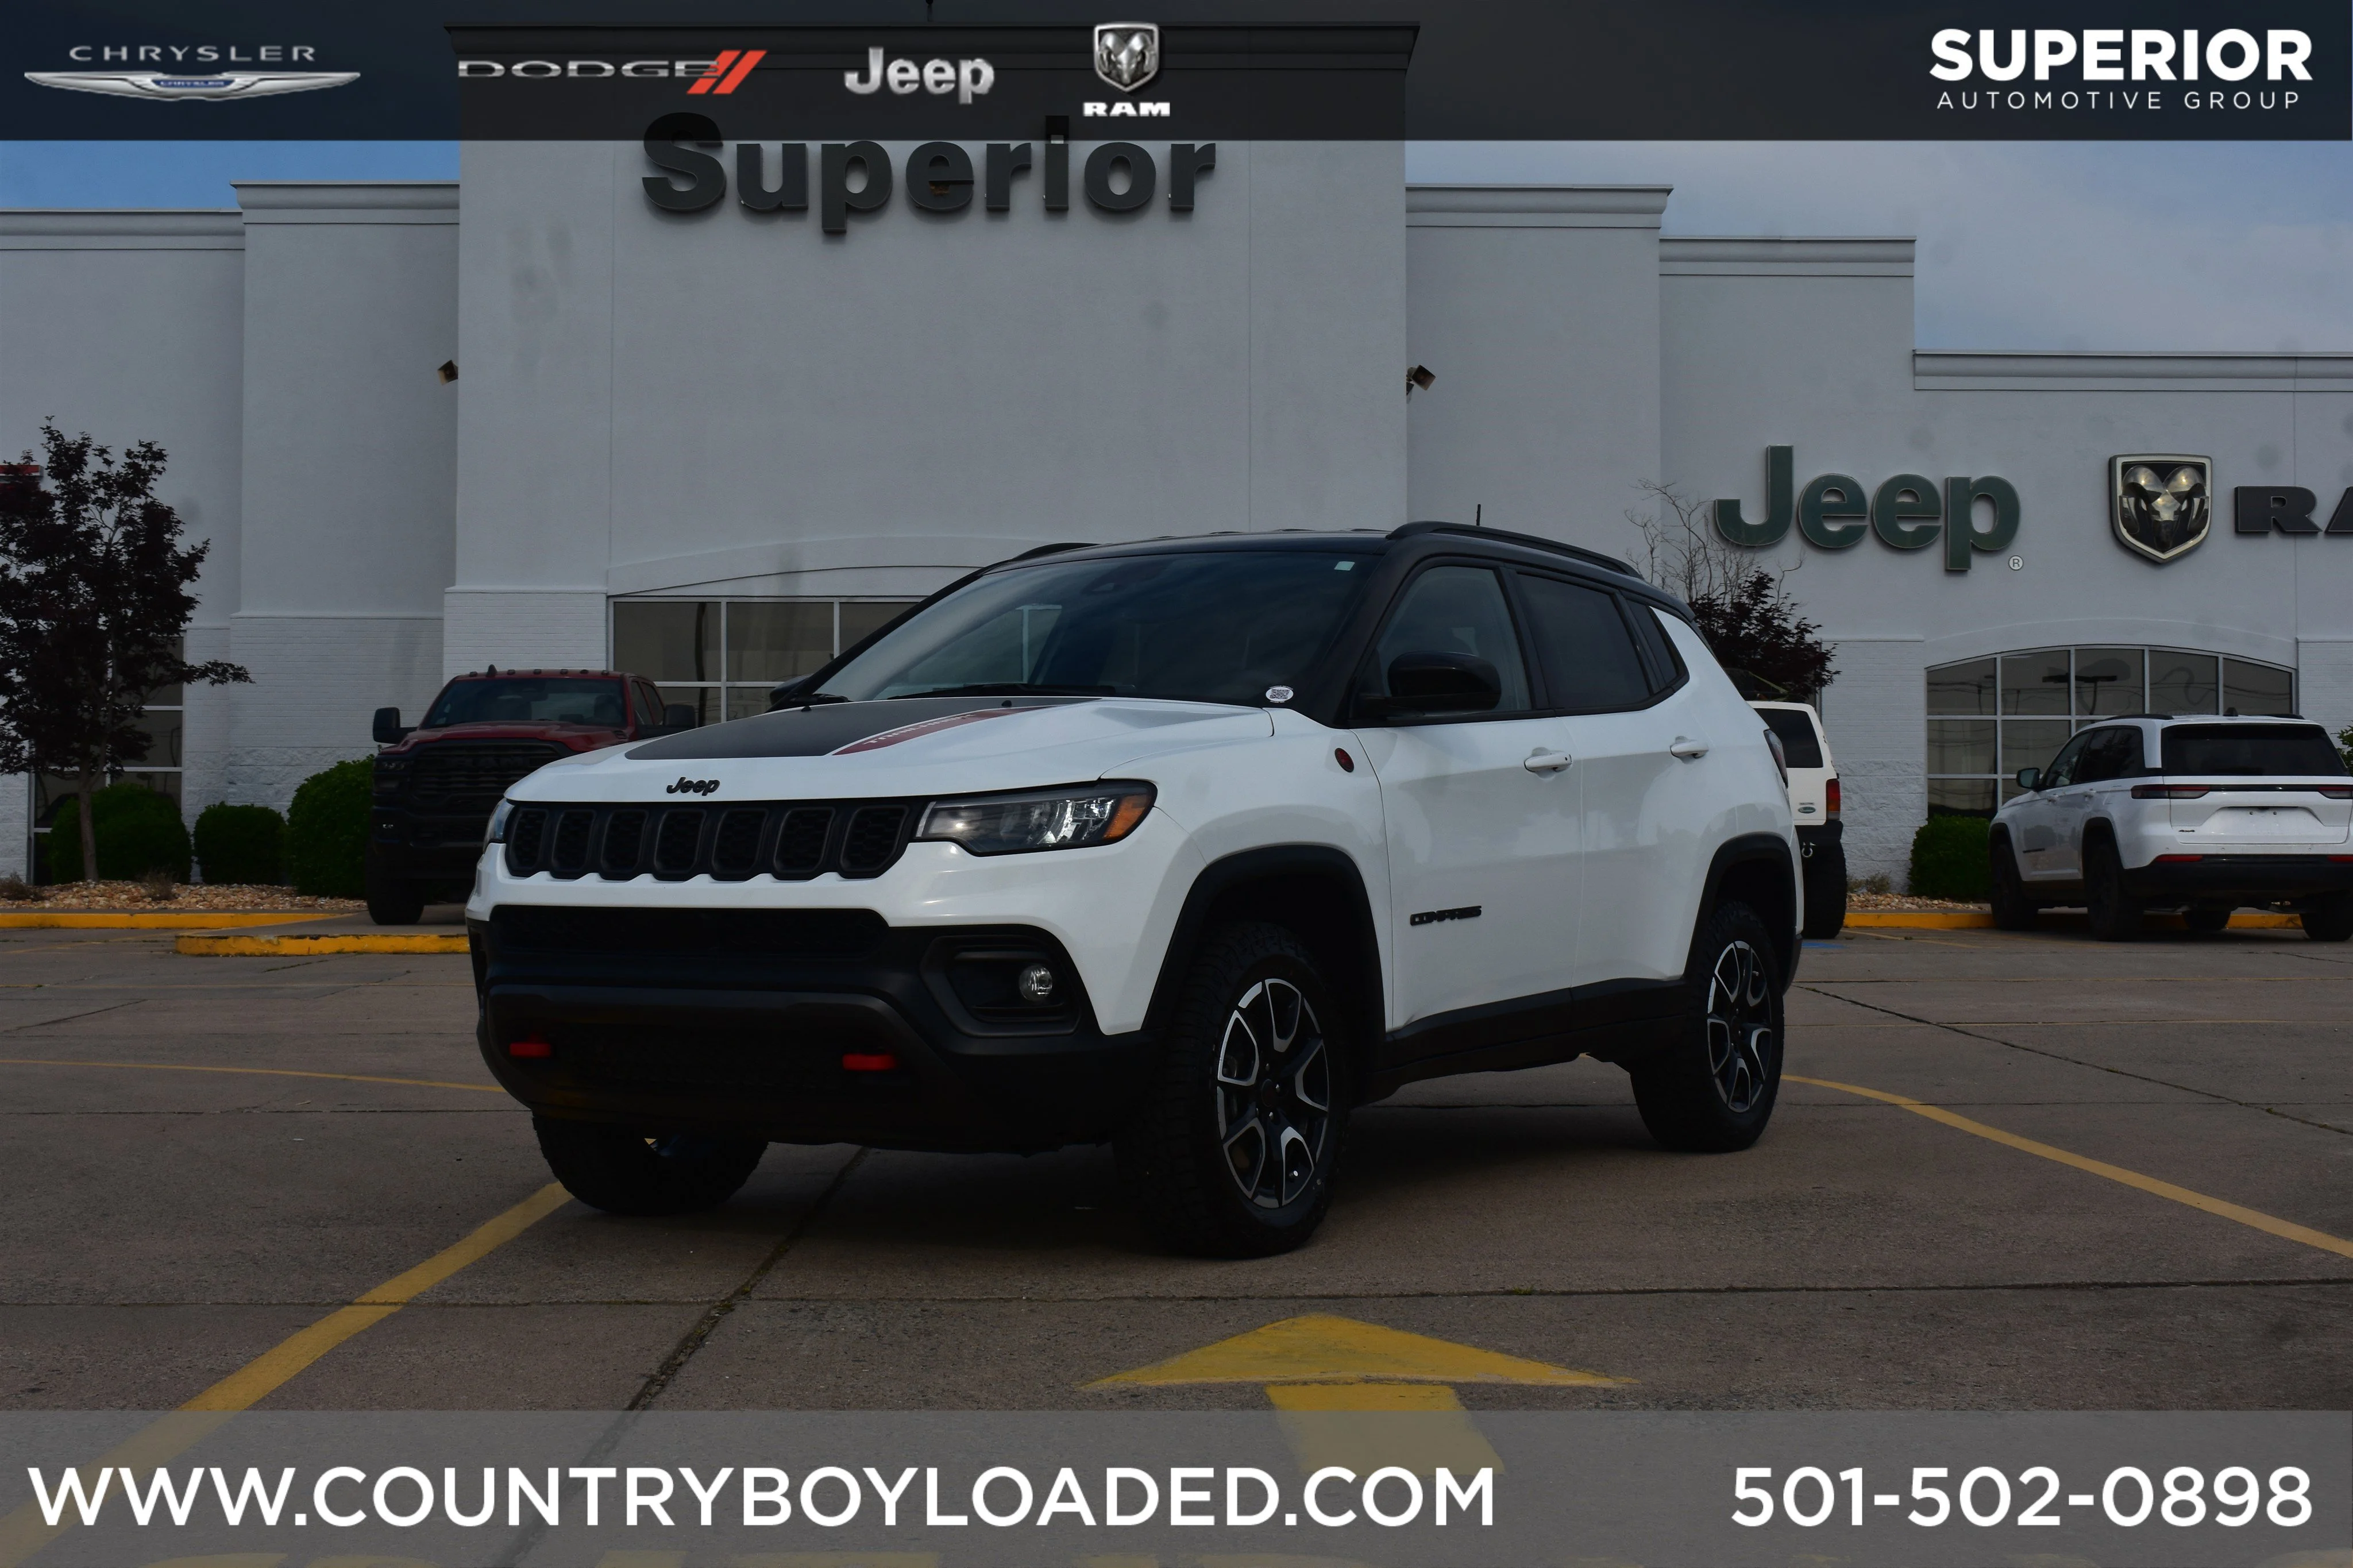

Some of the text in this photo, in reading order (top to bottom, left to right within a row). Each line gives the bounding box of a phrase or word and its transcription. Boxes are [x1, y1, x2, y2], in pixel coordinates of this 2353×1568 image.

[642, 112, 1216, 234] Superior
[1714, 445, 2021, 571] Jeep
[666, 777, 720, 797] Jeep
